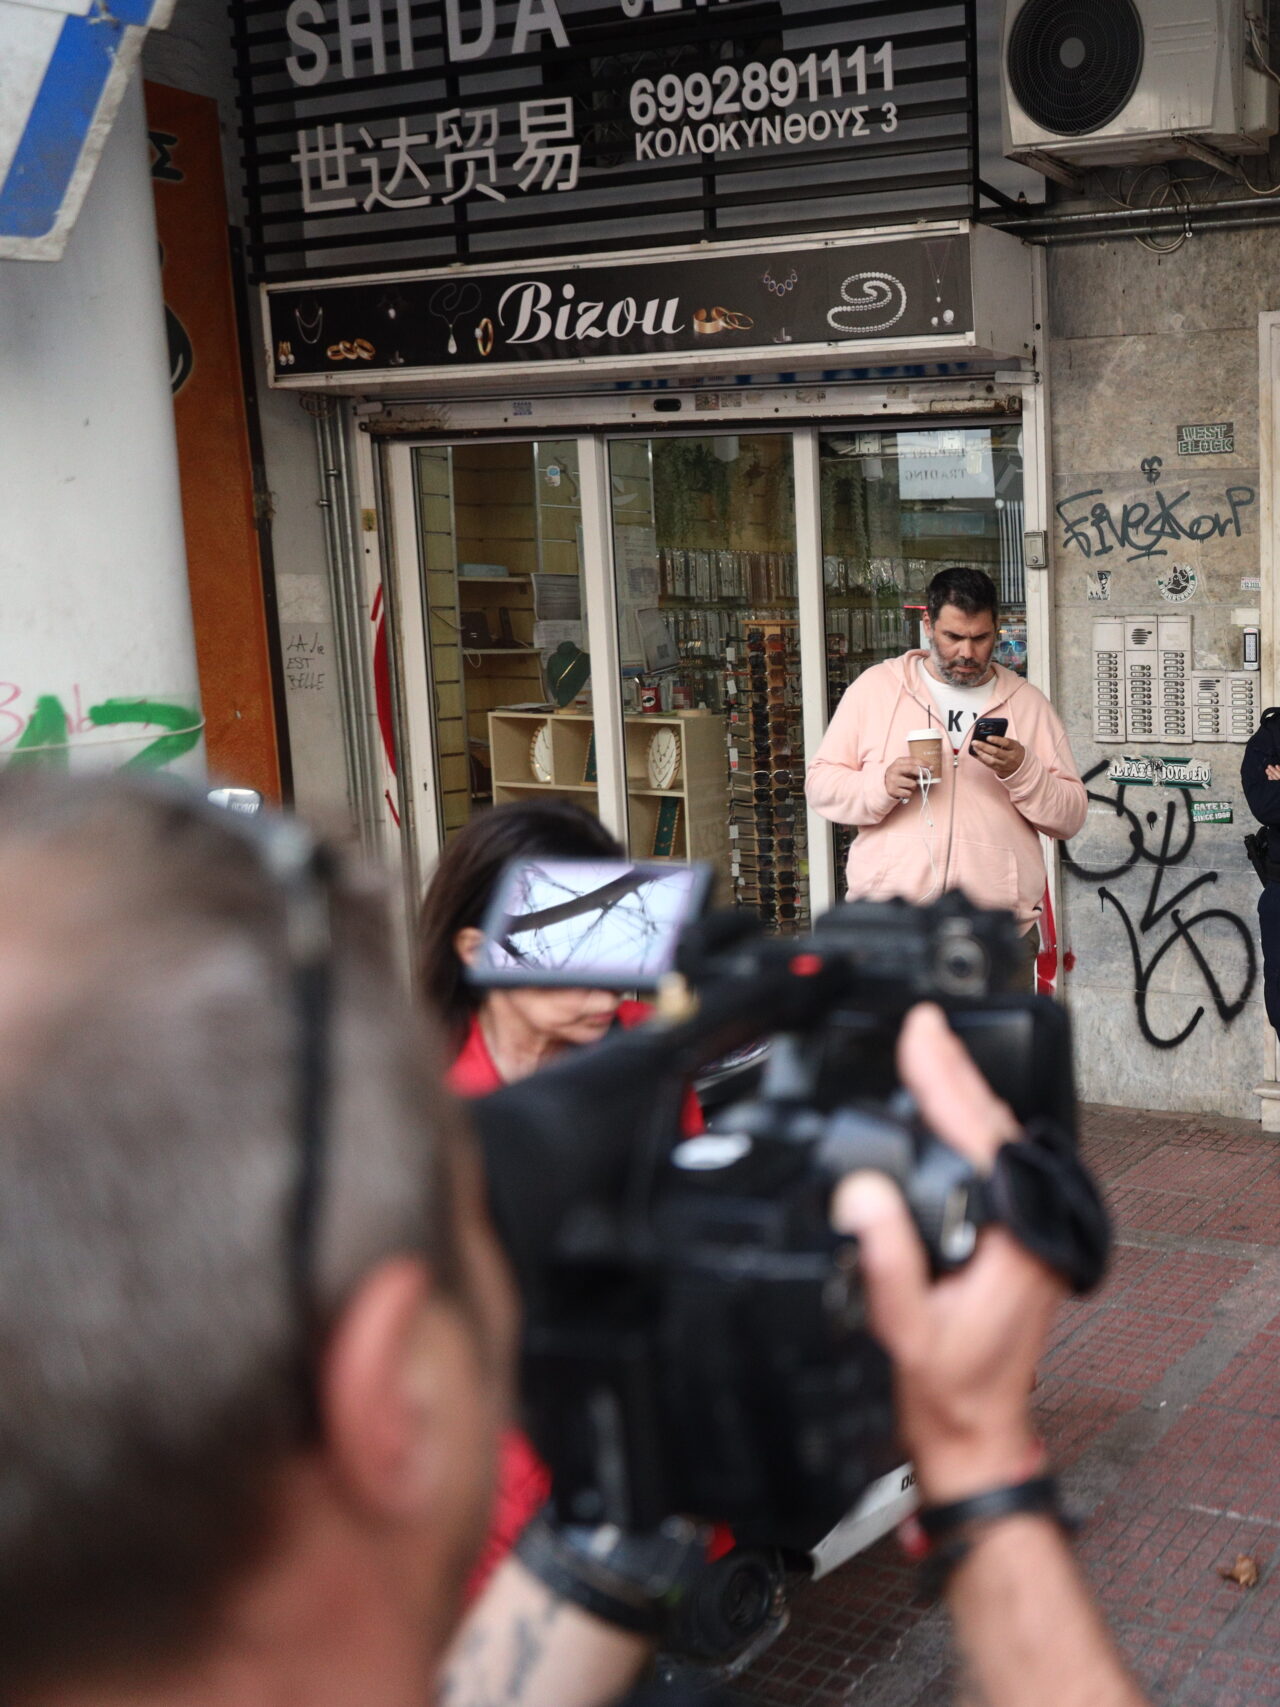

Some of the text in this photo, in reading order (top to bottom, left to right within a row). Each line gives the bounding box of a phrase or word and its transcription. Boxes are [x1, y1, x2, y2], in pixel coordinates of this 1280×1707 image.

[629, 41, 894, 126] 6992891111
[635, 102, 898, 161] ΚΟΛΟΚΥΝΘΟΥΣ 3
[290, 97, 582, 214] 世达贸易
[498, 280, 685, 344] Bizou
[1183, 425, 1227, 440] WEST
[1178, 438, 1233, 454] BLOCK
[286, 657, 315, 670] EST
[1193, 803, 1219, 811] GATE
[1193, 813, 1215, 822] SINCE
